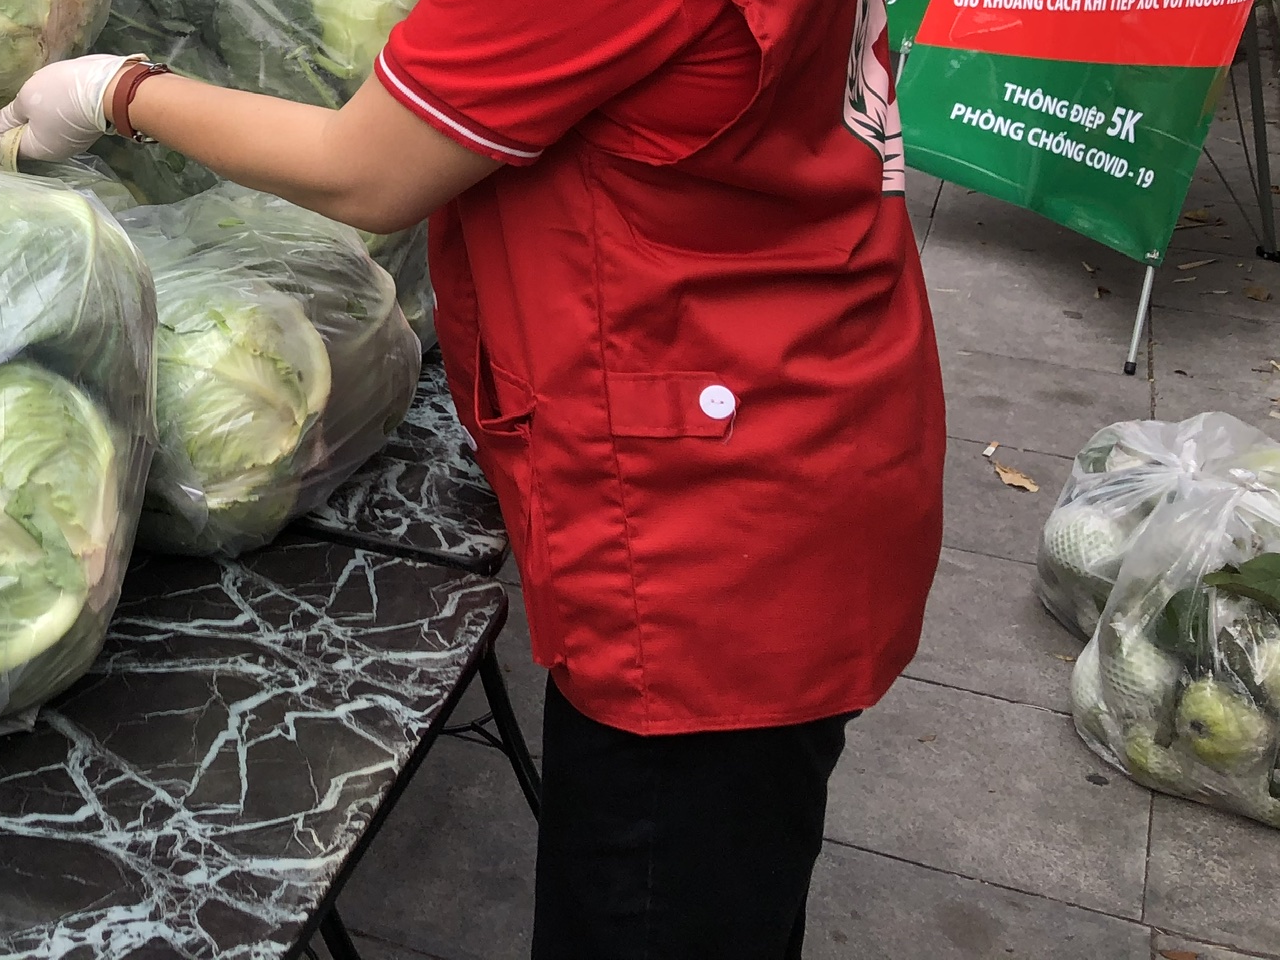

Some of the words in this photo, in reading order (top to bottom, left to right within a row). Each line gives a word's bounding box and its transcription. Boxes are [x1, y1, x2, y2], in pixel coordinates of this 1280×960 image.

[949, 102, 1025, 141] PHÒNG
[1027, 127, 1086, 162] CHỐNG
[1085, 148, 1129, 178] COVID
[1135, 167, 1155, 189] 19
[1004, 82, 1070, 119] THÔNG
[1069, 103, 1105, 132] ĐIỆP
[1106, 106, 1144, 144] 5K
